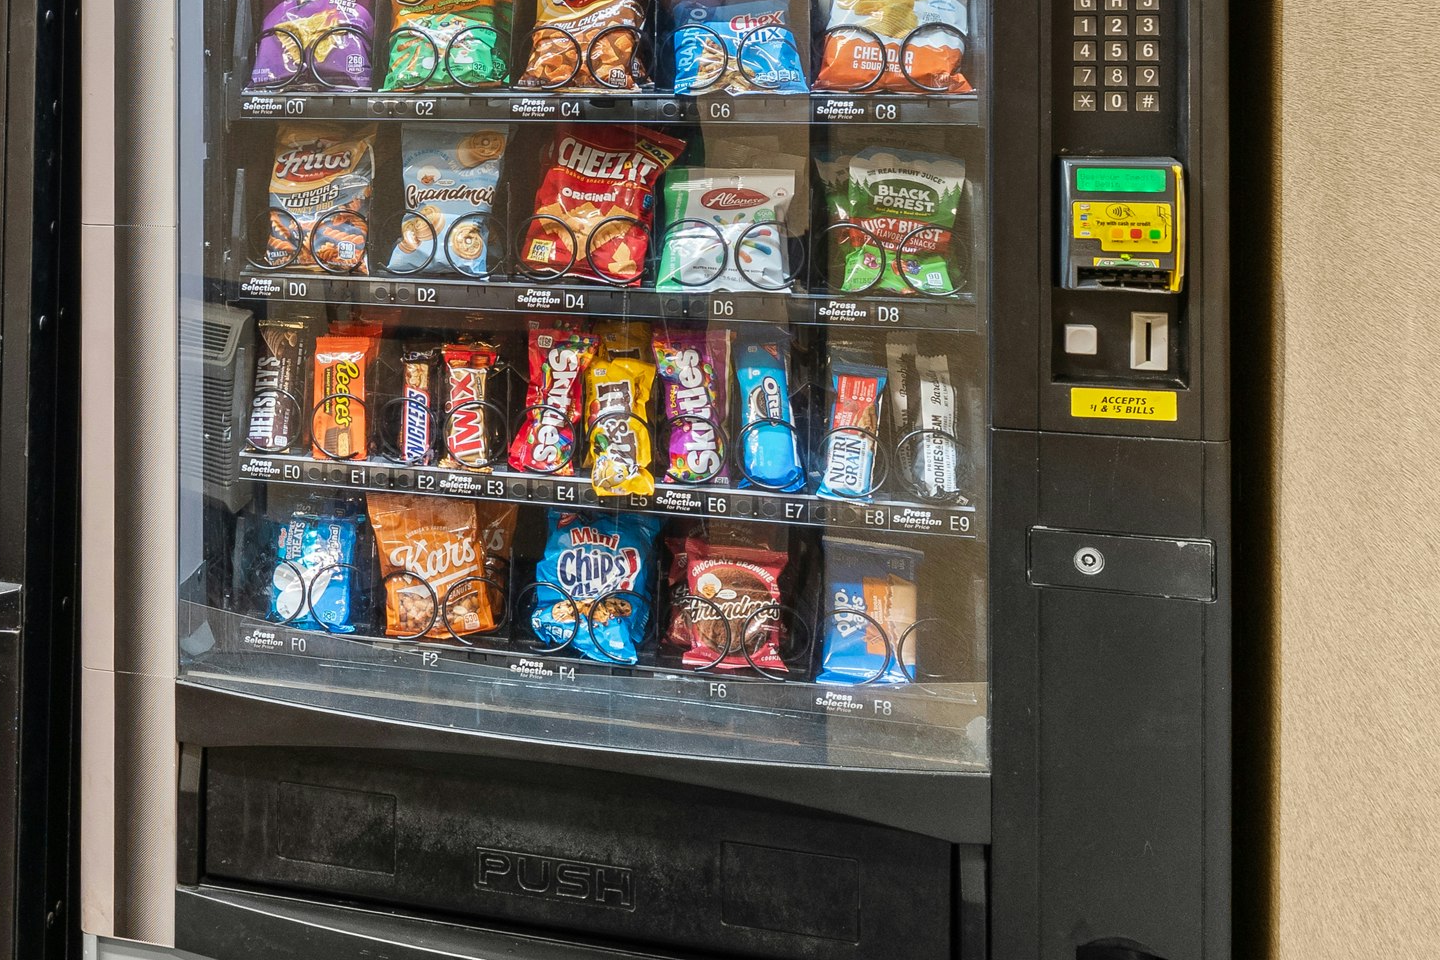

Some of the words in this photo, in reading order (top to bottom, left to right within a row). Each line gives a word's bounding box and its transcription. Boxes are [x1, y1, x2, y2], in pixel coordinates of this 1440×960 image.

[729, 11, 785, 31] Chex
[1081, 19, 1088, 32] 1
[1111, 18, 1122, 32] 2
[1143, 18, 1153, 32] 3
[853, 46, 914, 64] CHEDR
[1080, 44, 1090, 57] 4
[1111, 44, 1122, 57] 5
[1143, 44, 1153, 57] 6
[1082, 69, 1092, 82] 7
[1111, 69, 1123, 83] 8
[1143, 69, 1155, 83] 9
[415, 101, 433, 115] C2
[561, 102, 580, 116] C4
[826, 99, 854, 109] Press
[1111, 95, 1122, 108] 0
[710, 104, 730, 118] C6
[816, 106, 864, 116] Selection
[875, 104, 896, 119] C8
[276, 150, 352, 178] Fritos
[898, 167, 920, 177] FRUIT
[281, 188, 339, 208] TWISTS
[291, 185, 331, 198] FLAVOR
[406, 185, 495, 209] Grandma's
[878, 185, 931, 201] BLACK
[706, 192, 764, 207] Albanese
[418, 288, 436, 303] D2
[565, 293, 585, 309] D4
[713, 301, 734, 316] D6
[819, 308, 866, 317] Selection
[829, 301, 856, 310] Press
[878, 306, 899, 322] D8
[249, 357, 281, 437] HERSHEY'S
[1101, 396, 1147, 405] ACCEPTS
[1125, 406, 1155, 414] BILLS
[407, 388, 428, 461] SNICKERS
[830, 436, 847, 484] NUTRI
[845, 437, 862, 487] GRAIN
[351, 470, 366, 484] E1
[418, 475, 434, 490] E2
[487, 481, 504, 496] E3
[557, 485, 575, 501] E4
[708, 497, 727, 513] E6
[785, 504, 804, 518] E7
[865, 510, 885, 525] E8
[950, 516, 970, 531] E9
[293, 522, 306, 558] TREATS
[571, 527, 620, 550] Mini
[559, 548, 626, 586] Chips
[692, 558, 733, 577] CHOCOLATE
[736, 560, 774, 583] BROWNIE
[422, 652, 438, 667] F2
[559, 666, 576, 681] F4
[709, 683, 727, 698] F6
[874, 700, 892, 716] F8
[479, 852, 630, 906] PUSH
